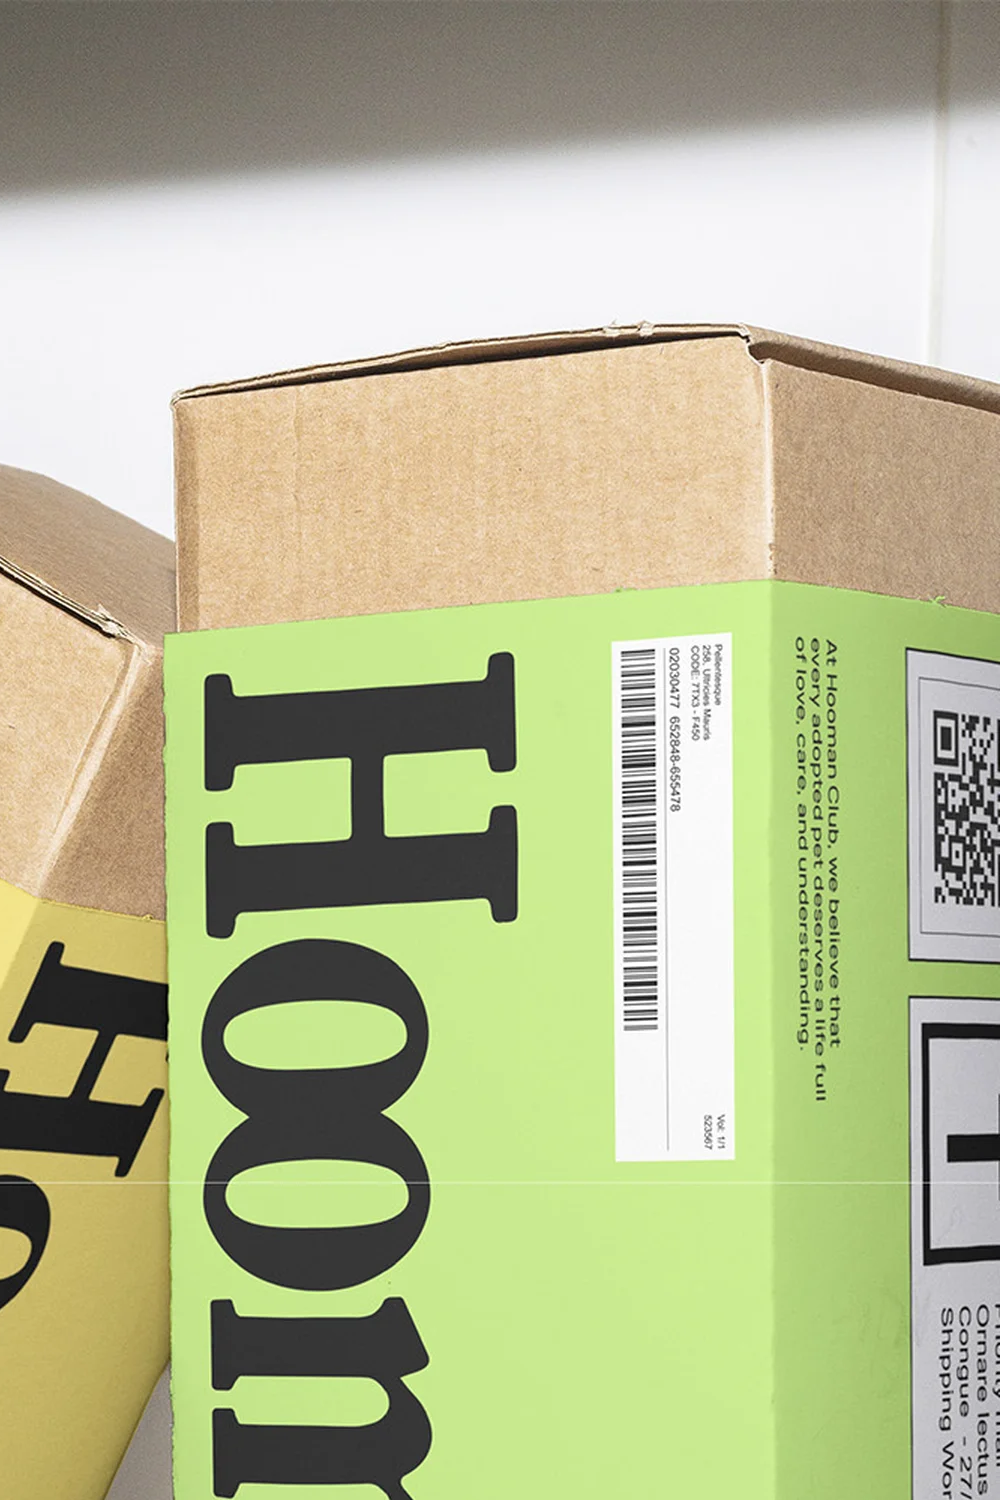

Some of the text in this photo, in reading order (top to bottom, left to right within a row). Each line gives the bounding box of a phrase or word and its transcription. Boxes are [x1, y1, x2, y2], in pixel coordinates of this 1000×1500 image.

[690, 644, 701, 677] CODE:
[691, 682, 701, 708] 7TX3
[713, 643, 723, 706] Pellentesque
[668, 647, 681, 813] 02030477 652848-655478
[691, 716, 701, 741] F450
[795, 636, 812, 1051] of love, care, and understanding.
[808, 637, 826, 1101] every adopted pet deserves a life full
[826, 639, 841, 1047] At Hooman Club, we believe that
[703, 1114, 713, 1150] 523567
[938, 1307, 954, 1431] Shipping
[956, 1306, 972, 1417] Congue
[976, 1304, 990, 1496] Ornare lectus
